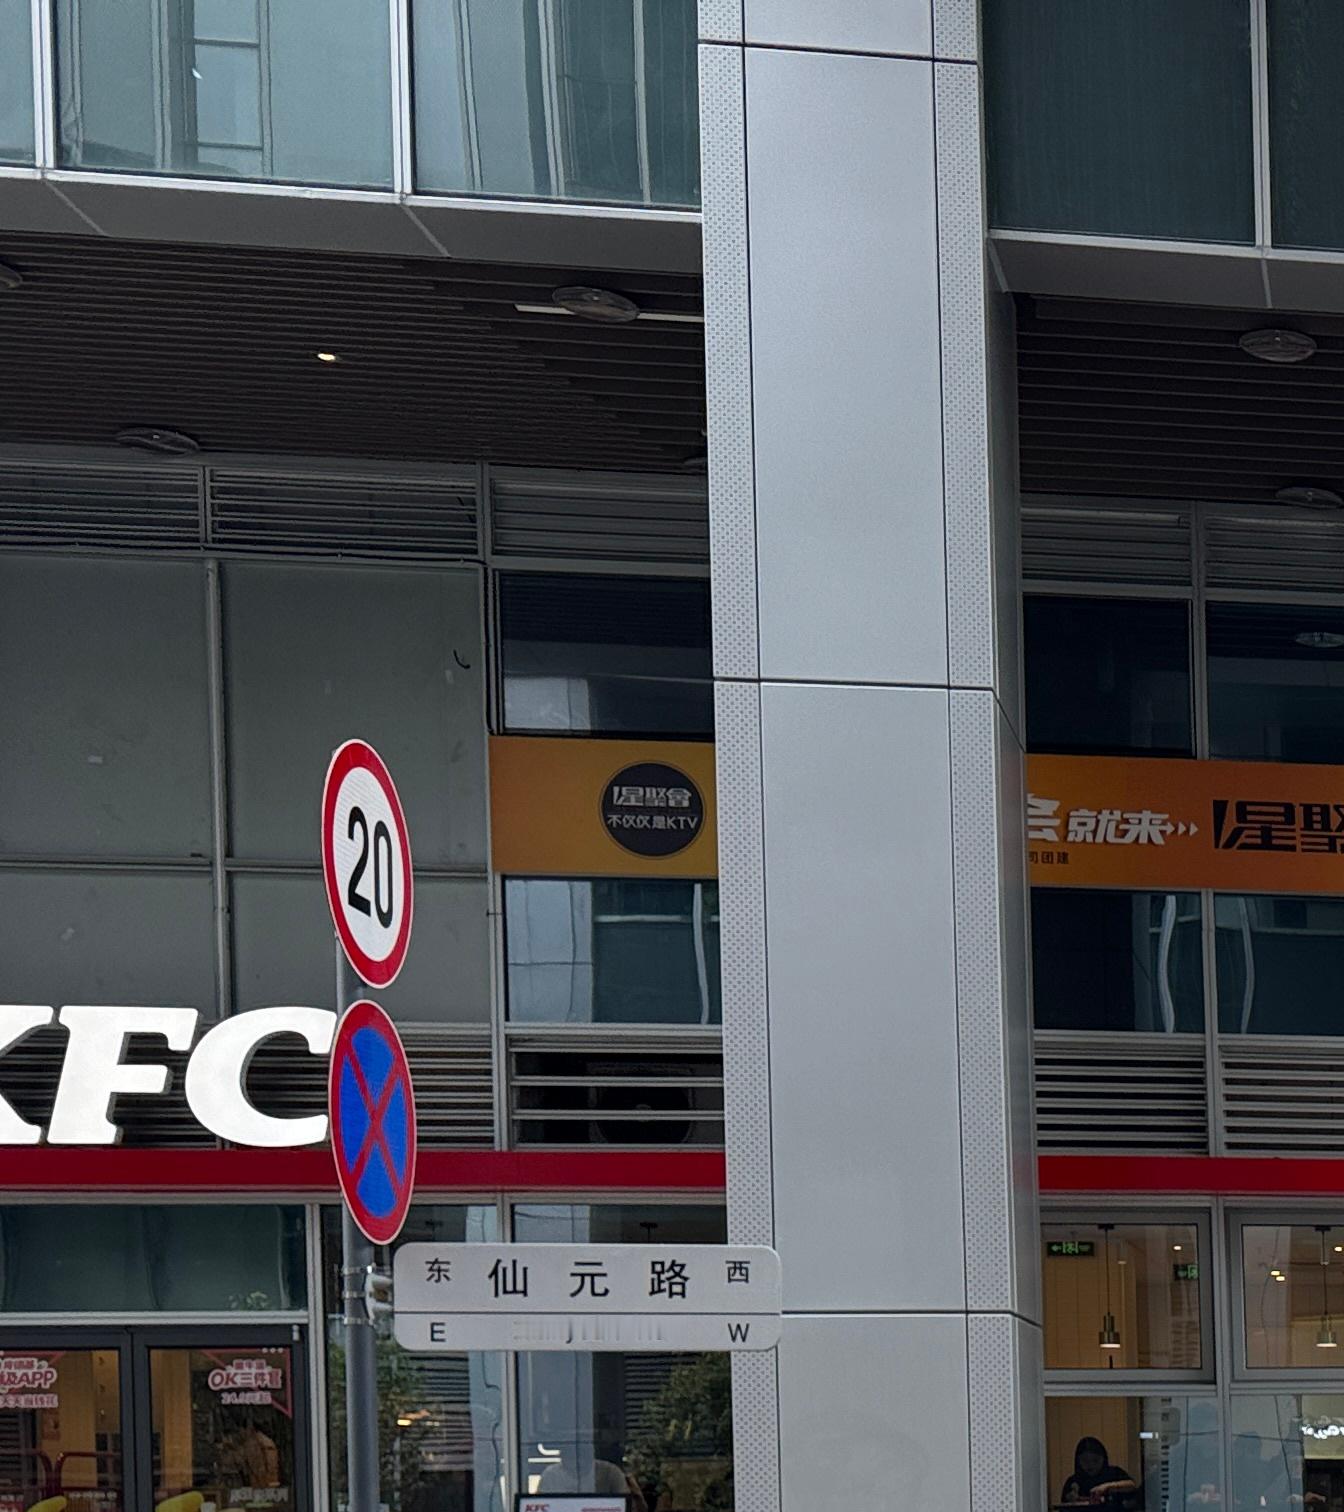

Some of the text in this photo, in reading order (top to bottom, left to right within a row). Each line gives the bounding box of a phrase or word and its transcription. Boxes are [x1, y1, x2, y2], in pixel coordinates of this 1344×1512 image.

[347, 806, 394, 929] 20
[425, 1257, 751, 1300] 东 仙元路 西
[429, 1321, 751, 1344] E W
